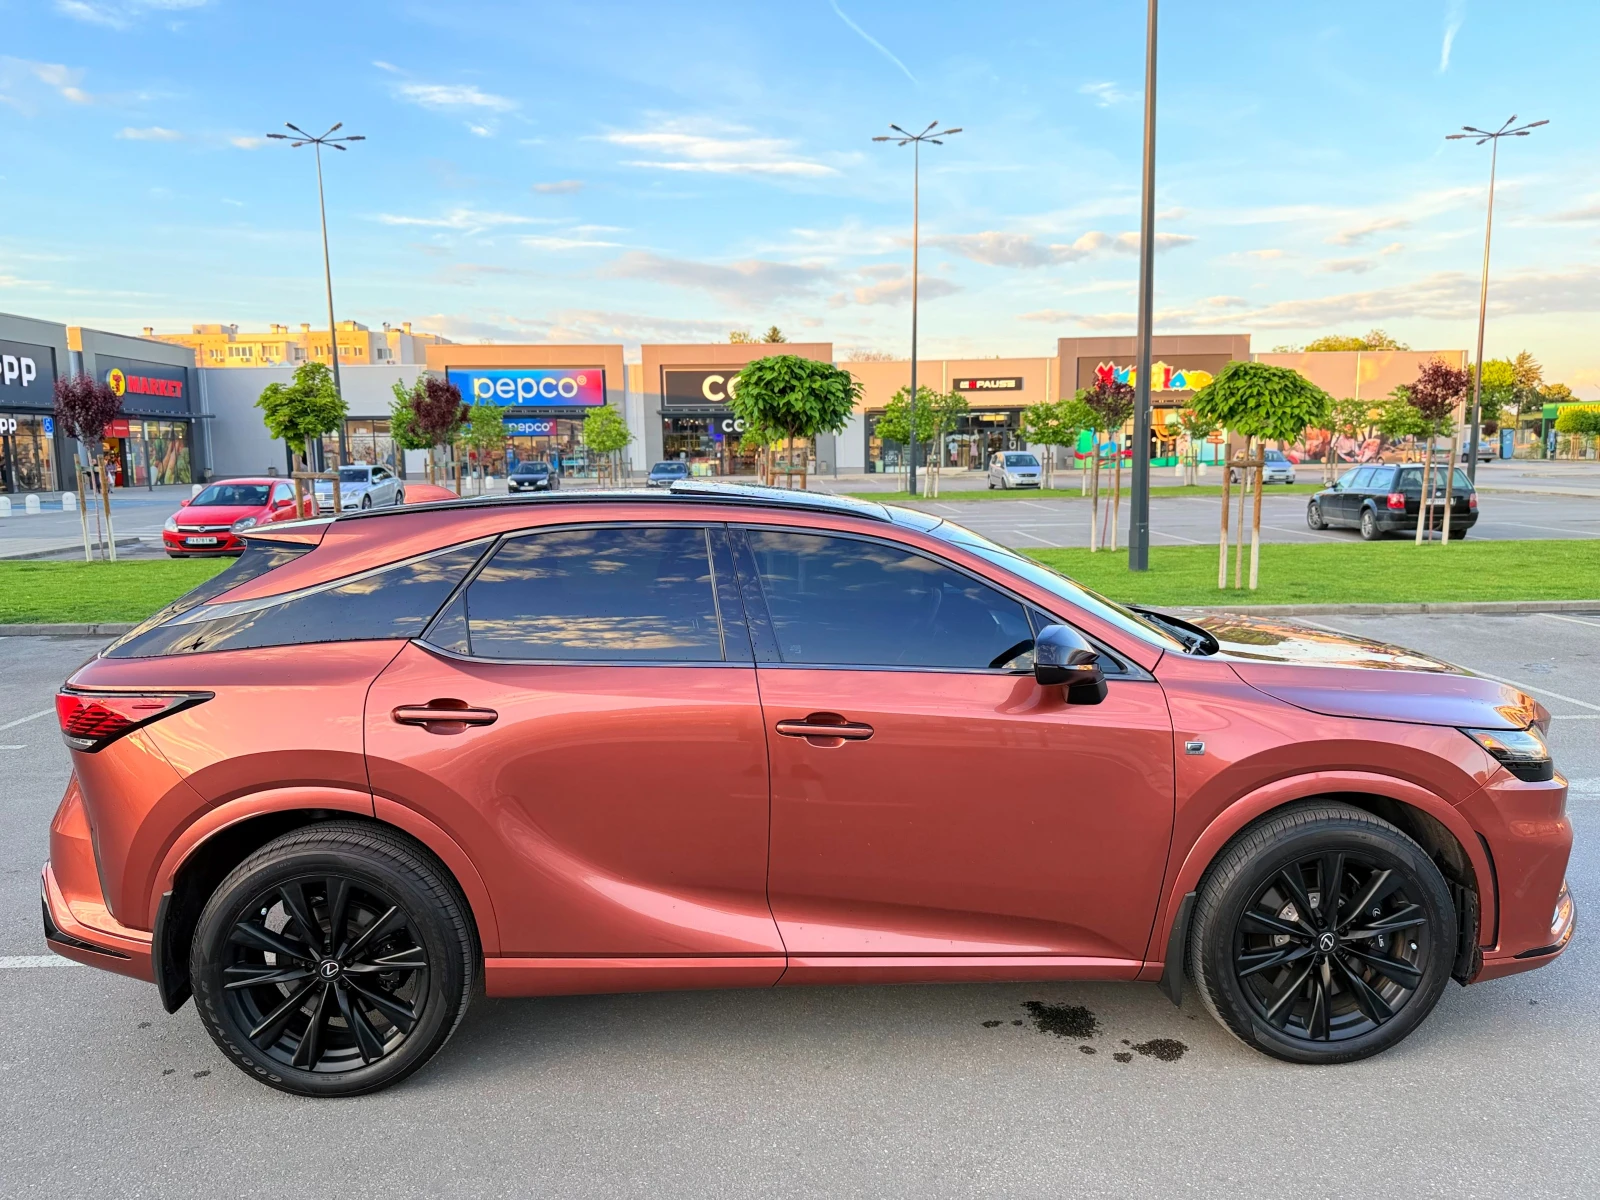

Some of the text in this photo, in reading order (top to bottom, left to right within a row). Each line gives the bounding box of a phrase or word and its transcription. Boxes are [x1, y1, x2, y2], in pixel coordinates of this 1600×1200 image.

[127, 375, 182, 398] MARKET
[473, 377, 578, 403] pepco
[508, 422, 550, 434] pepco
[201, 979, 283, 1083] GOODYEAR
